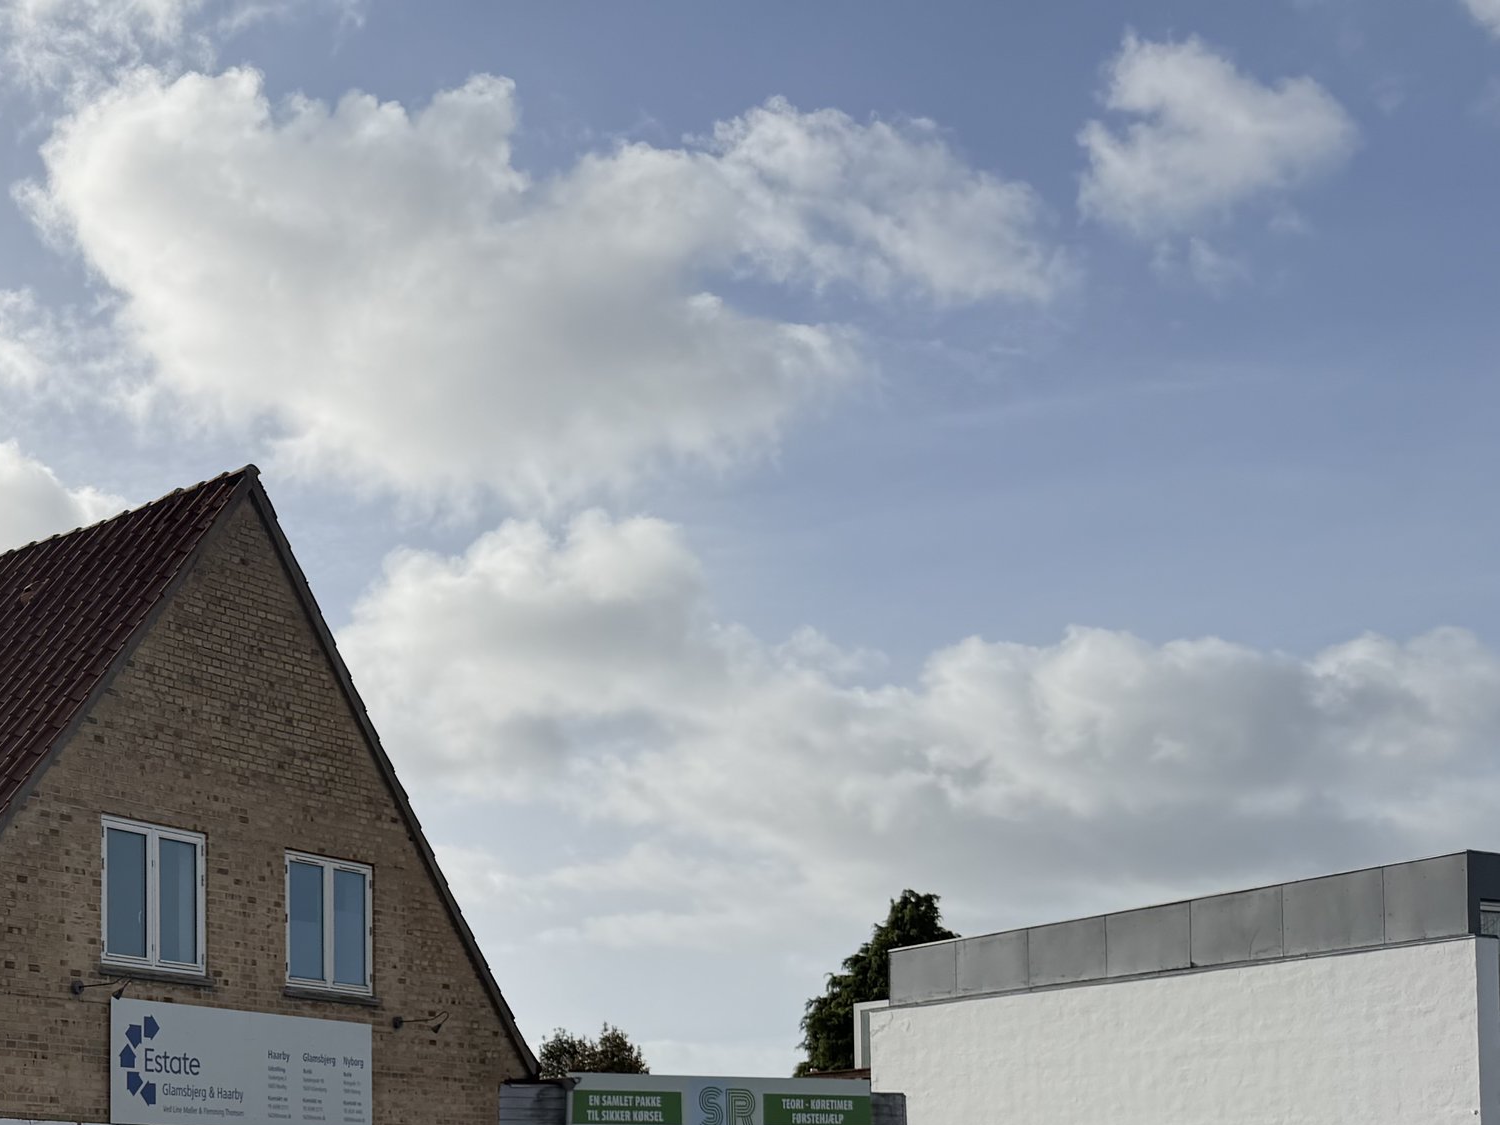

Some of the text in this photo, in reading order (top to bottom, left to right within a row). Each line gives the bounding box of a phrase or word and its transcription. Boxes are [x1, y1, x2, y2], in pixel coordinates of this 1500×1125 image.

[144, 1048, 200, 1075] Estate
[268, 1050, 290, 1062] Haarby
[303, 1053, 336, 1067] Glamsbjerg
[343, 1056, 364, 1069] Nyborg
[162, 1083, 244, 1103] Glamsbjerg & Haarby
[588, 1095, 662, 1107] EN SAMLET PAKKE
[782, 1099, 804, 1110] TEORI
[810, 1100, 853, 1111] KØRETIMER
[587, 1110, 664, 1122] TIL SIKKER KØRSEL
[792, 1113, 844, 1125] FØRSTEHJÆLP
